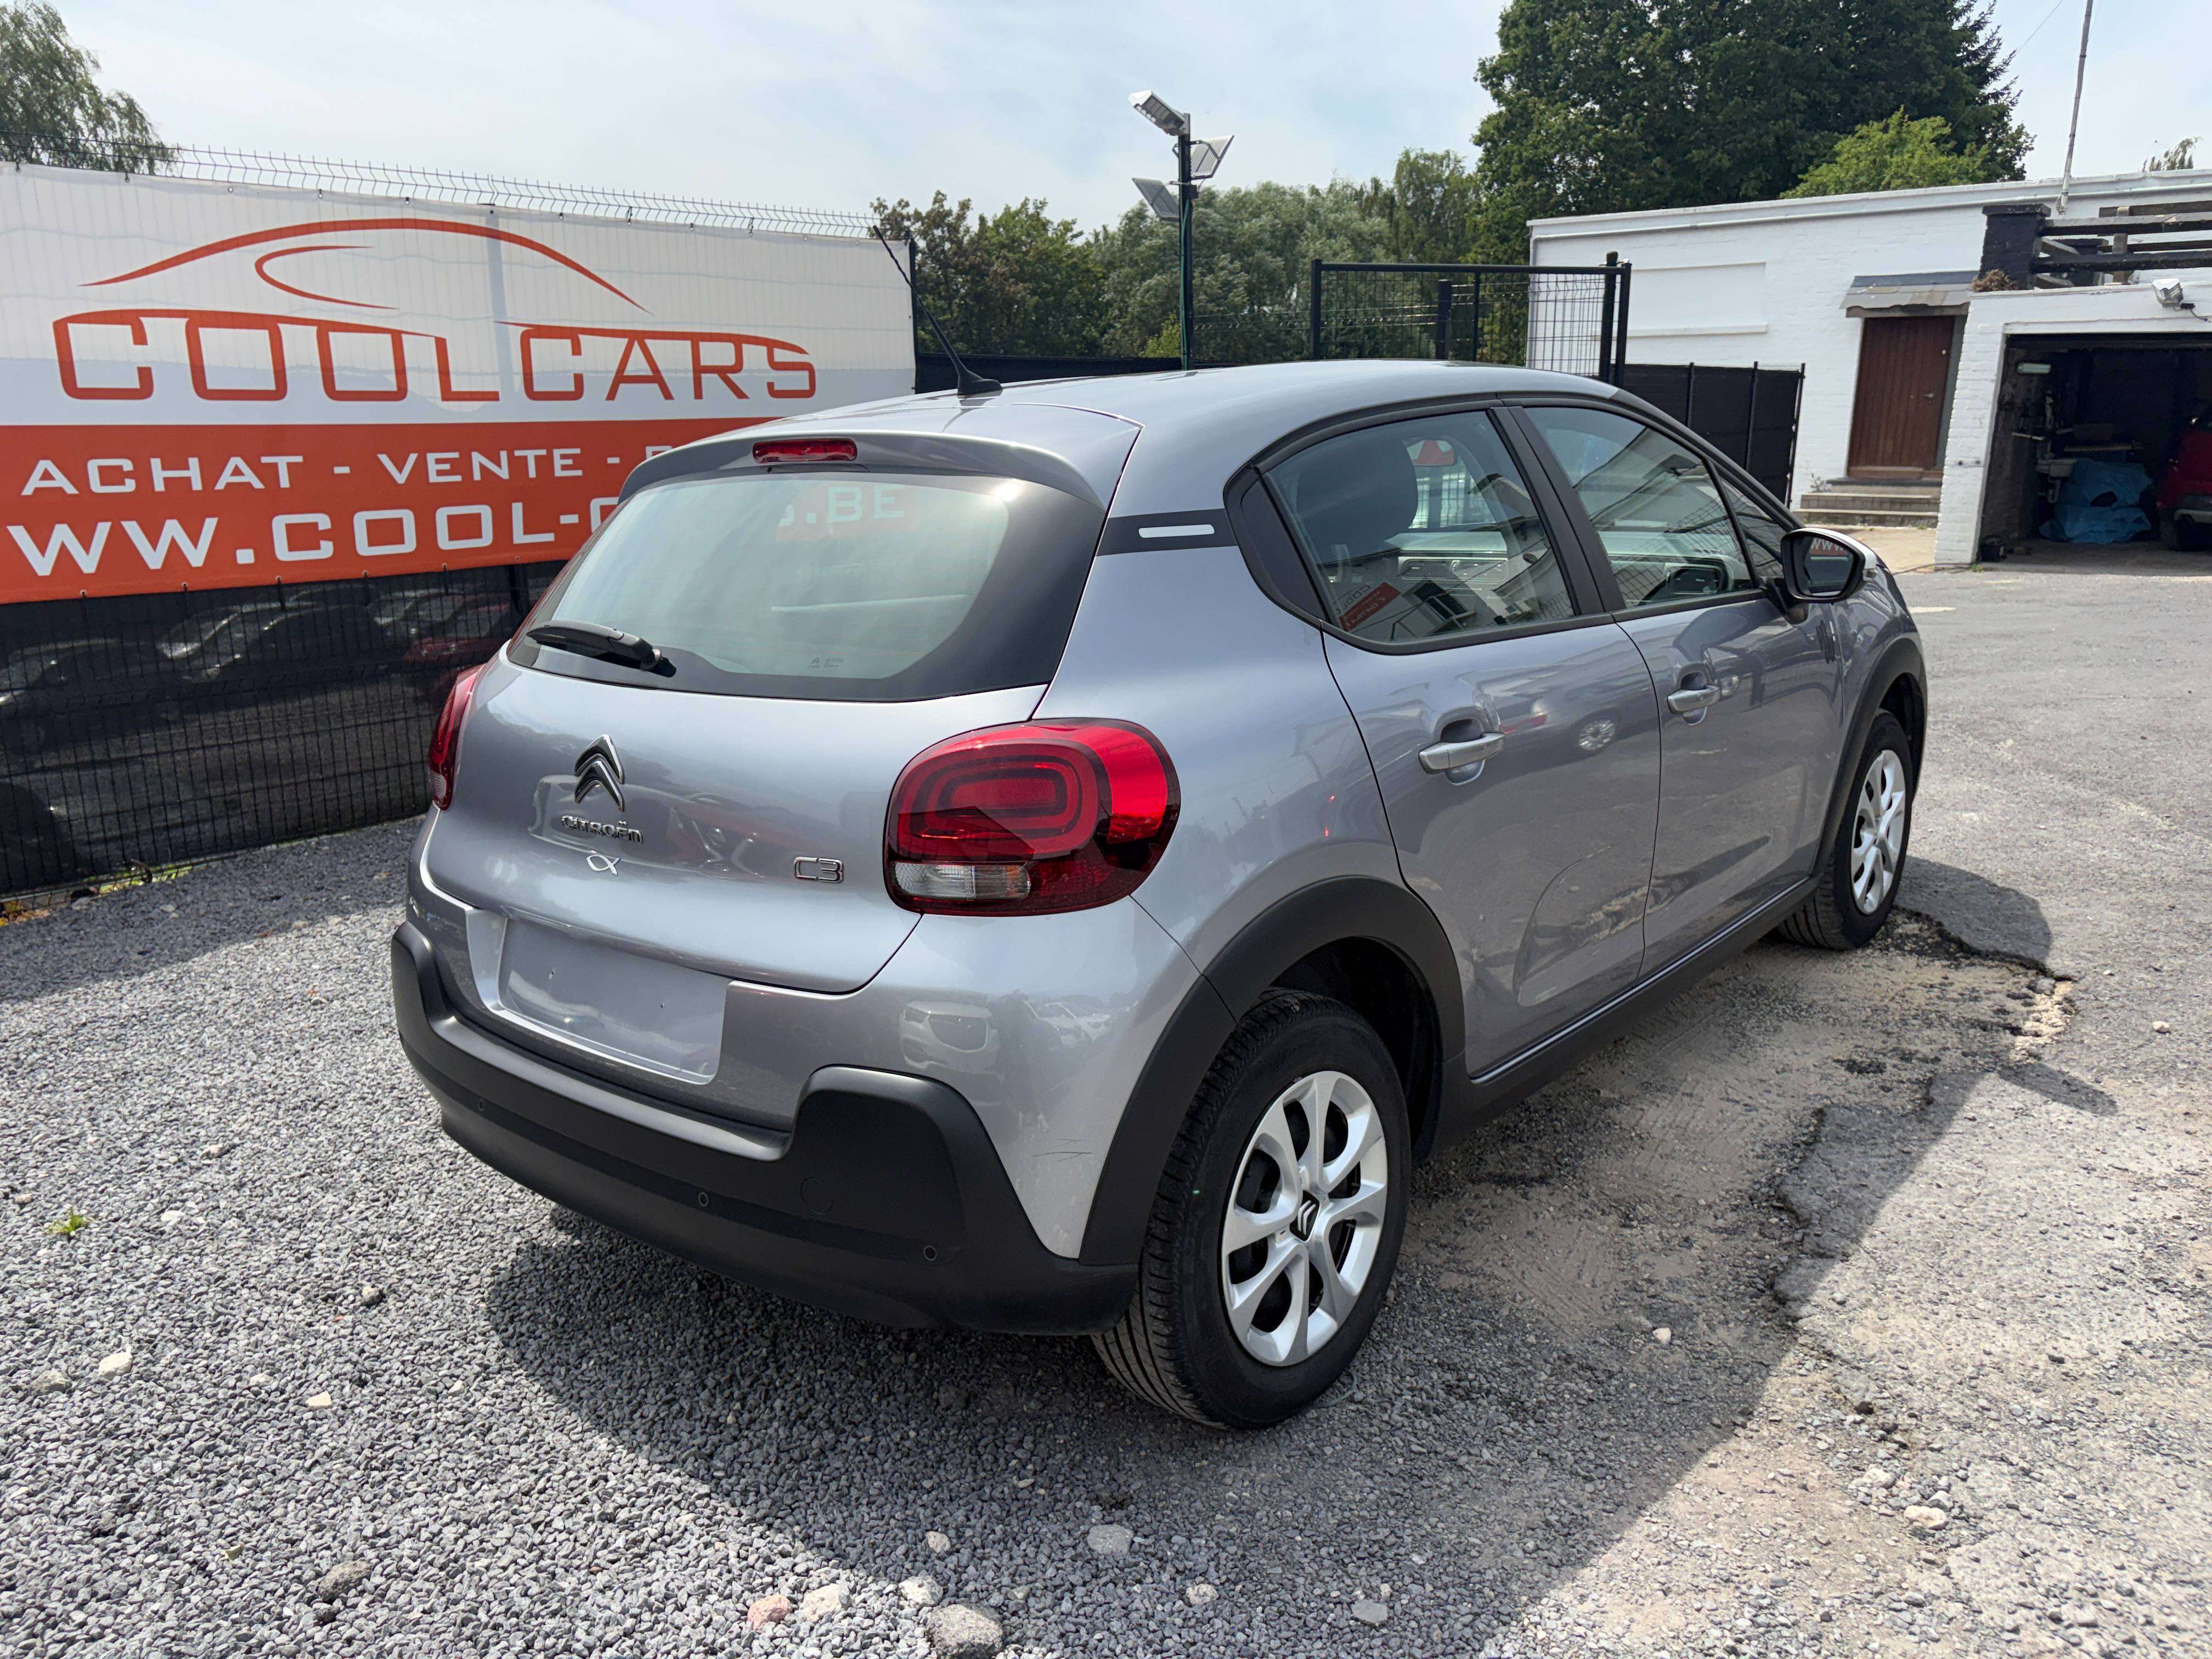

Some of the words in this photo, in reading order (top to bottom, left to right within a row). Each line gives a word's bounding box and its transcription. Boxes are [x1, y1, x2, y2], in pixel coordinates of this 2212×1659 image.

[53, 309, 500, 402] COOL
[520, 328, 816, 401] CARS
[20, 455, 303, 496] ACHAT
[333, 466, 351, 475] -
[376, 447, 583, 484] VENTE
[793, 856, 844, 883] C3
